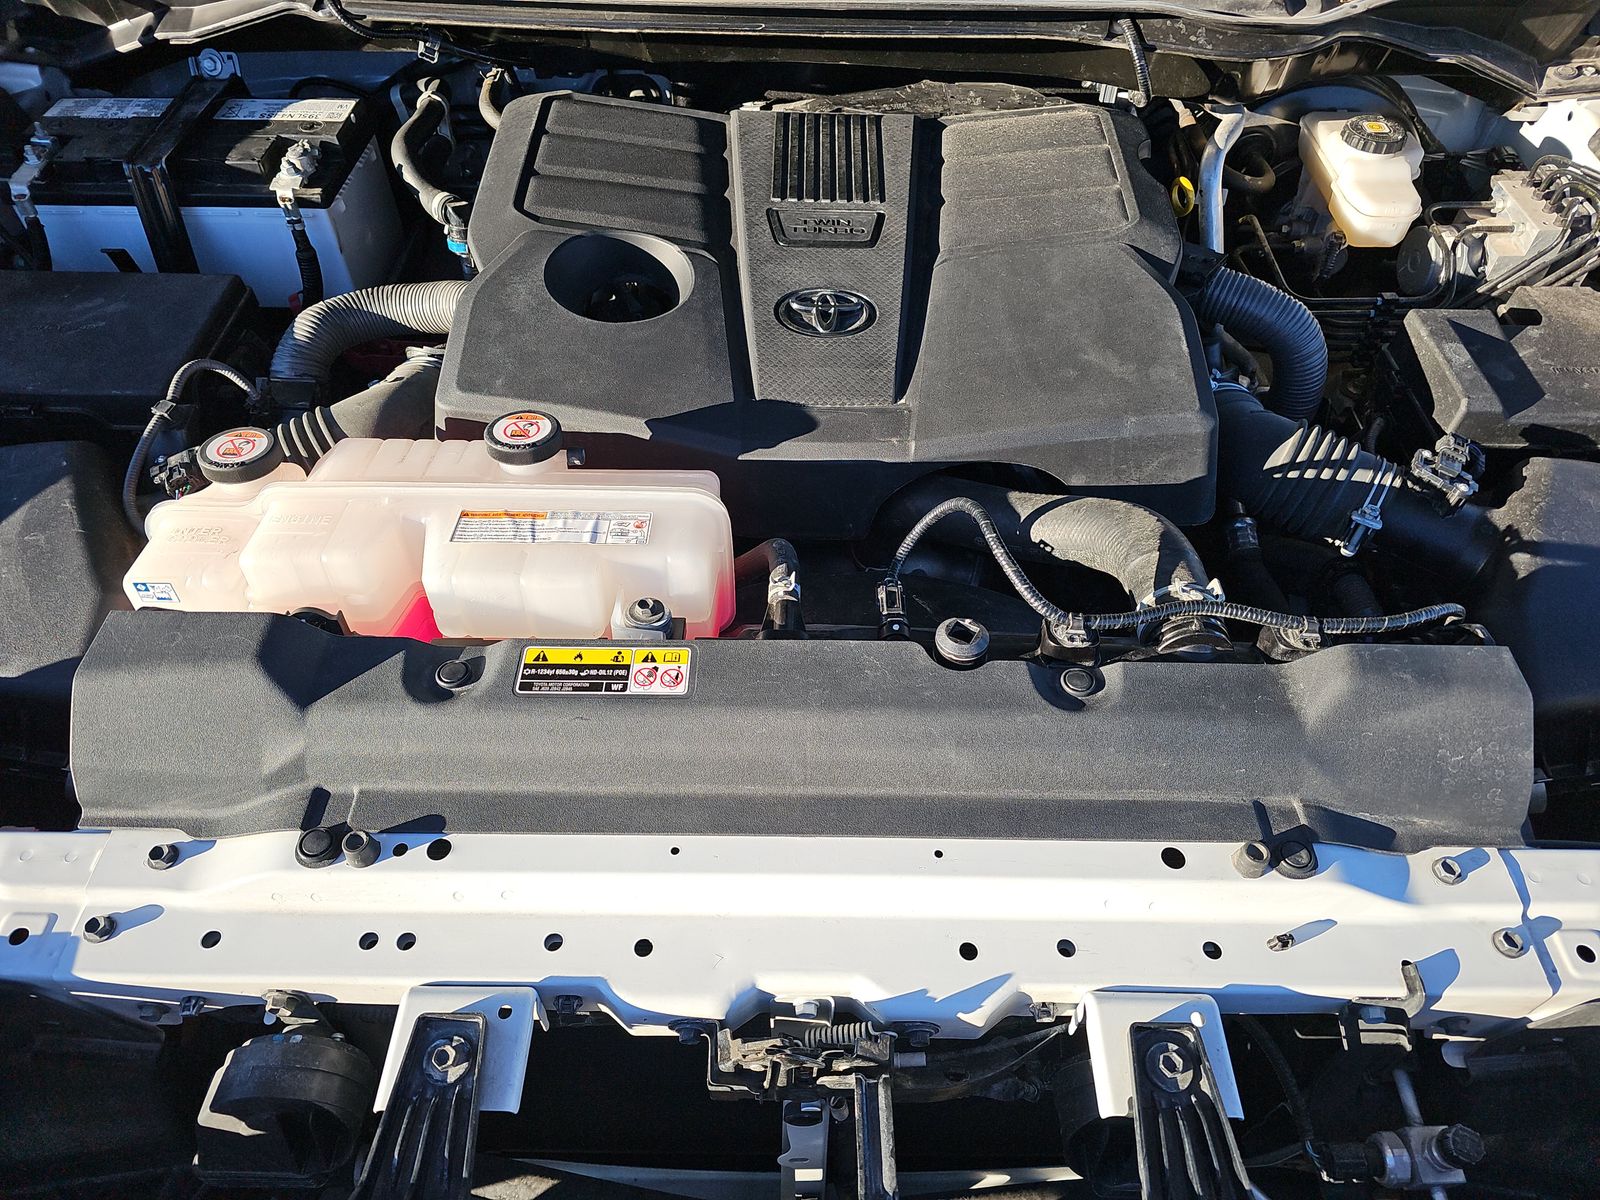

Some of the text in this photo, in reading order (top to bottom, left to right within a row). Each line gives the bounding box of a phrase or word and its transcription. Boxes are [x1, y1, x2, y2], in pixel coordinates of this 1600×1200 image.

[798, 218, 853, 227] TWIN
[787, 225, 868, 235] TURBO
[611, 683, 624, 691] WF
